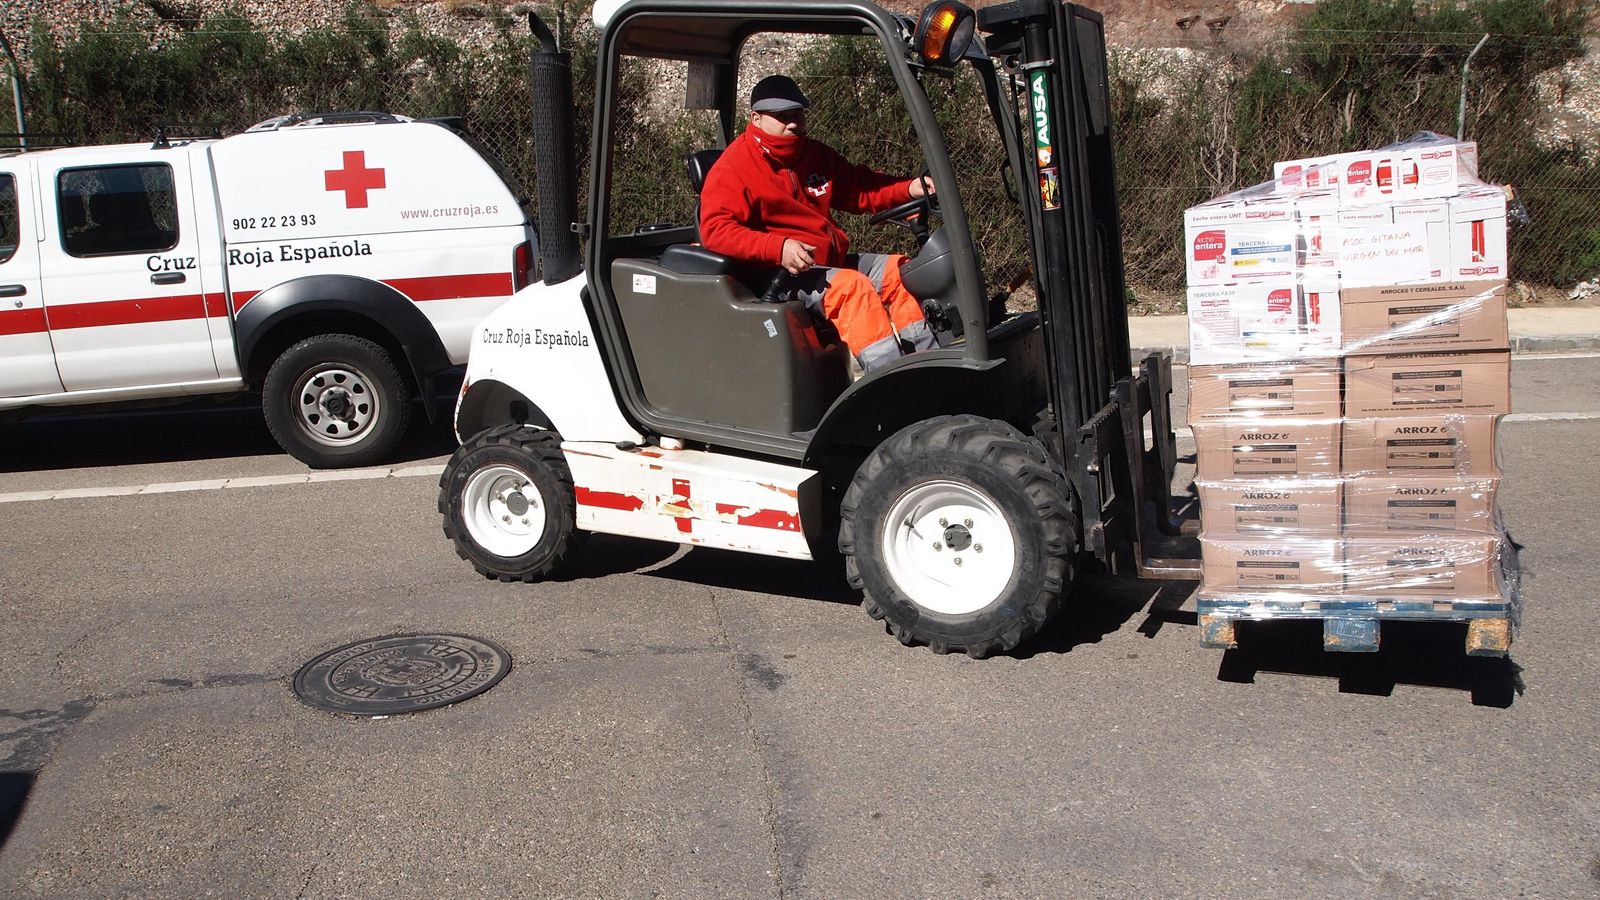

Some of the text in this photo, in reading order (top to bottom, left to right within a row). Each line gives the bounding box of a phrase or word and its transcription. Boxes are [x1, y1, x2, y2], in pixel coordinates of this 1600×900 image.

[1032, 75, 1050, 145] AUSA
[400, 204, 499, 220] www.cruzroja.es
[232, 214, 316, 230] 902 22 23 93
[1371, 232, 1411, 243] GITANA
[146, 240, 372, 273] Cruz Roja Española
[1343, 245, 1424, 262] VIRGEN DEL MAR
[483, 328, 589, 349] Cruz Roja Española
[414, 658, 494, 704] SANEAMIENTO
